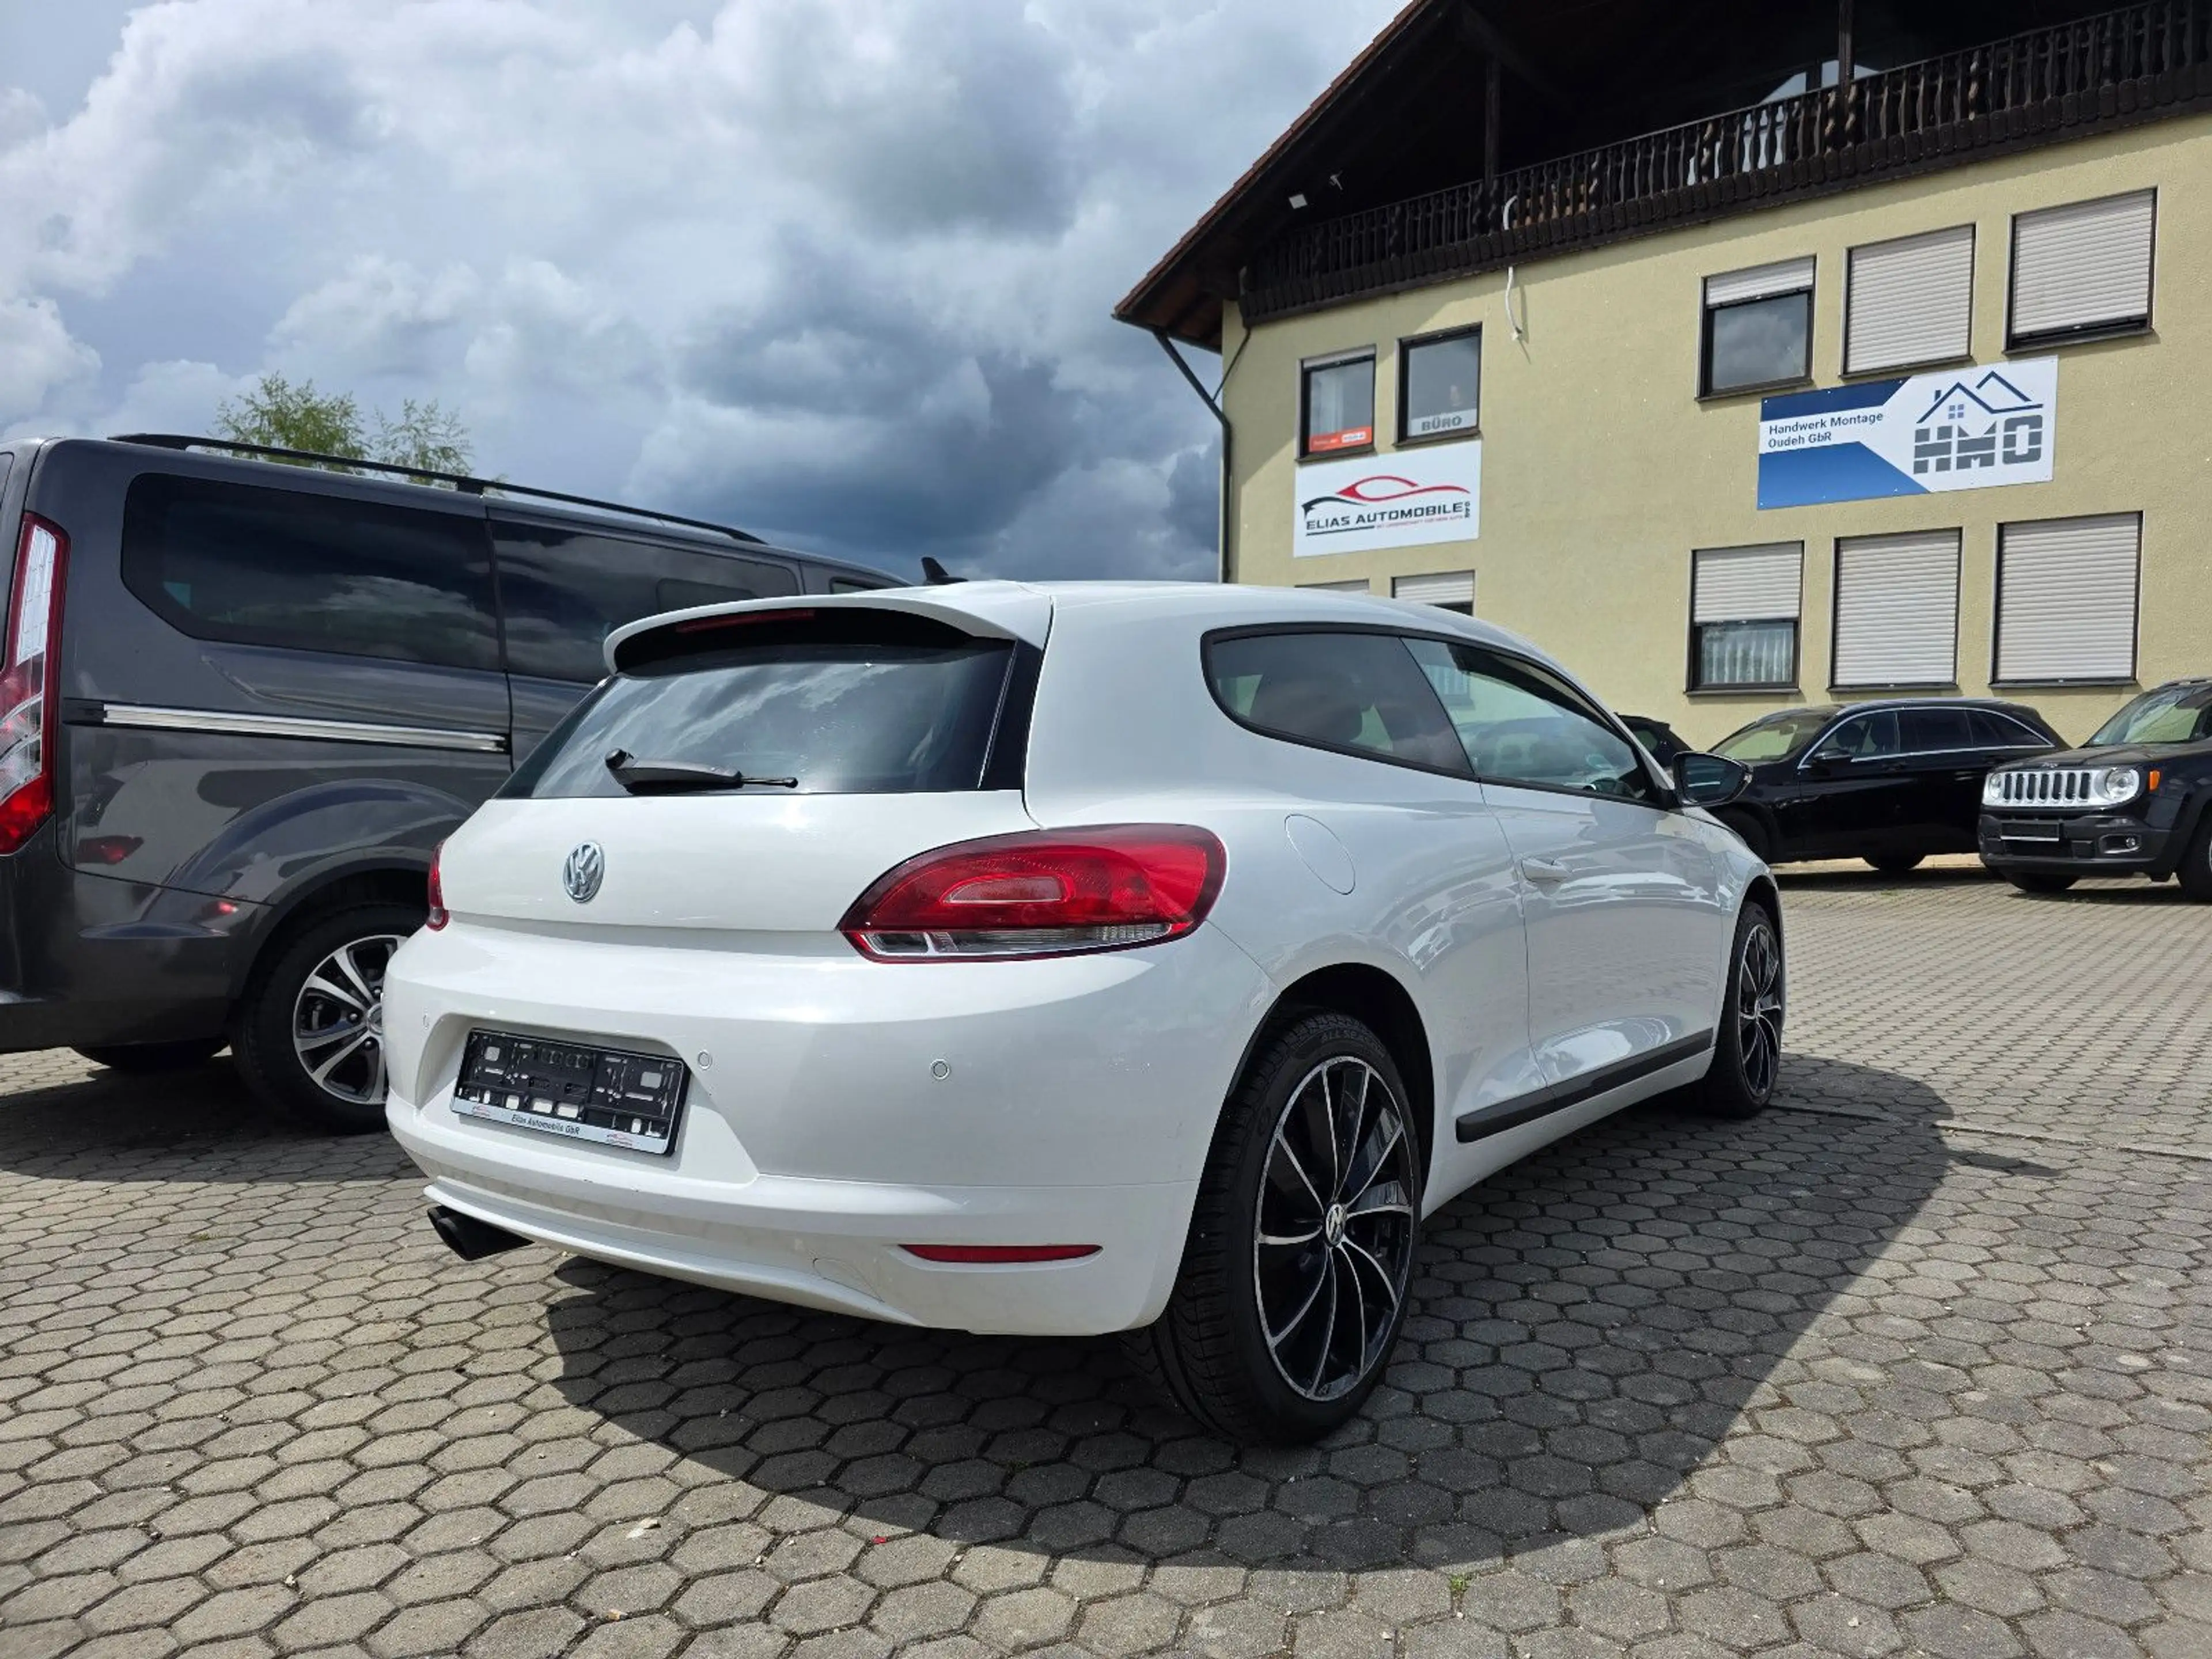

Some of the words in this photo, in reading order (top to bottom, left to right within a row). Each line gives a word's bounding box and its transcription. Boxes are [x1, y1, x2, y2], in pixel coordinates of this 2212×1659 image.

[1769, 419, 1827, 435] Handwerk
[1830, 413, 1884, 427] Montage
[1768, 435, 1805, 448] Oudeh
[1808, 431, 1832, 444] GbR
[1306, 516, 1350, 530] ELIAS
[1356, 502, 1464, 524] AUTOMOBILE
